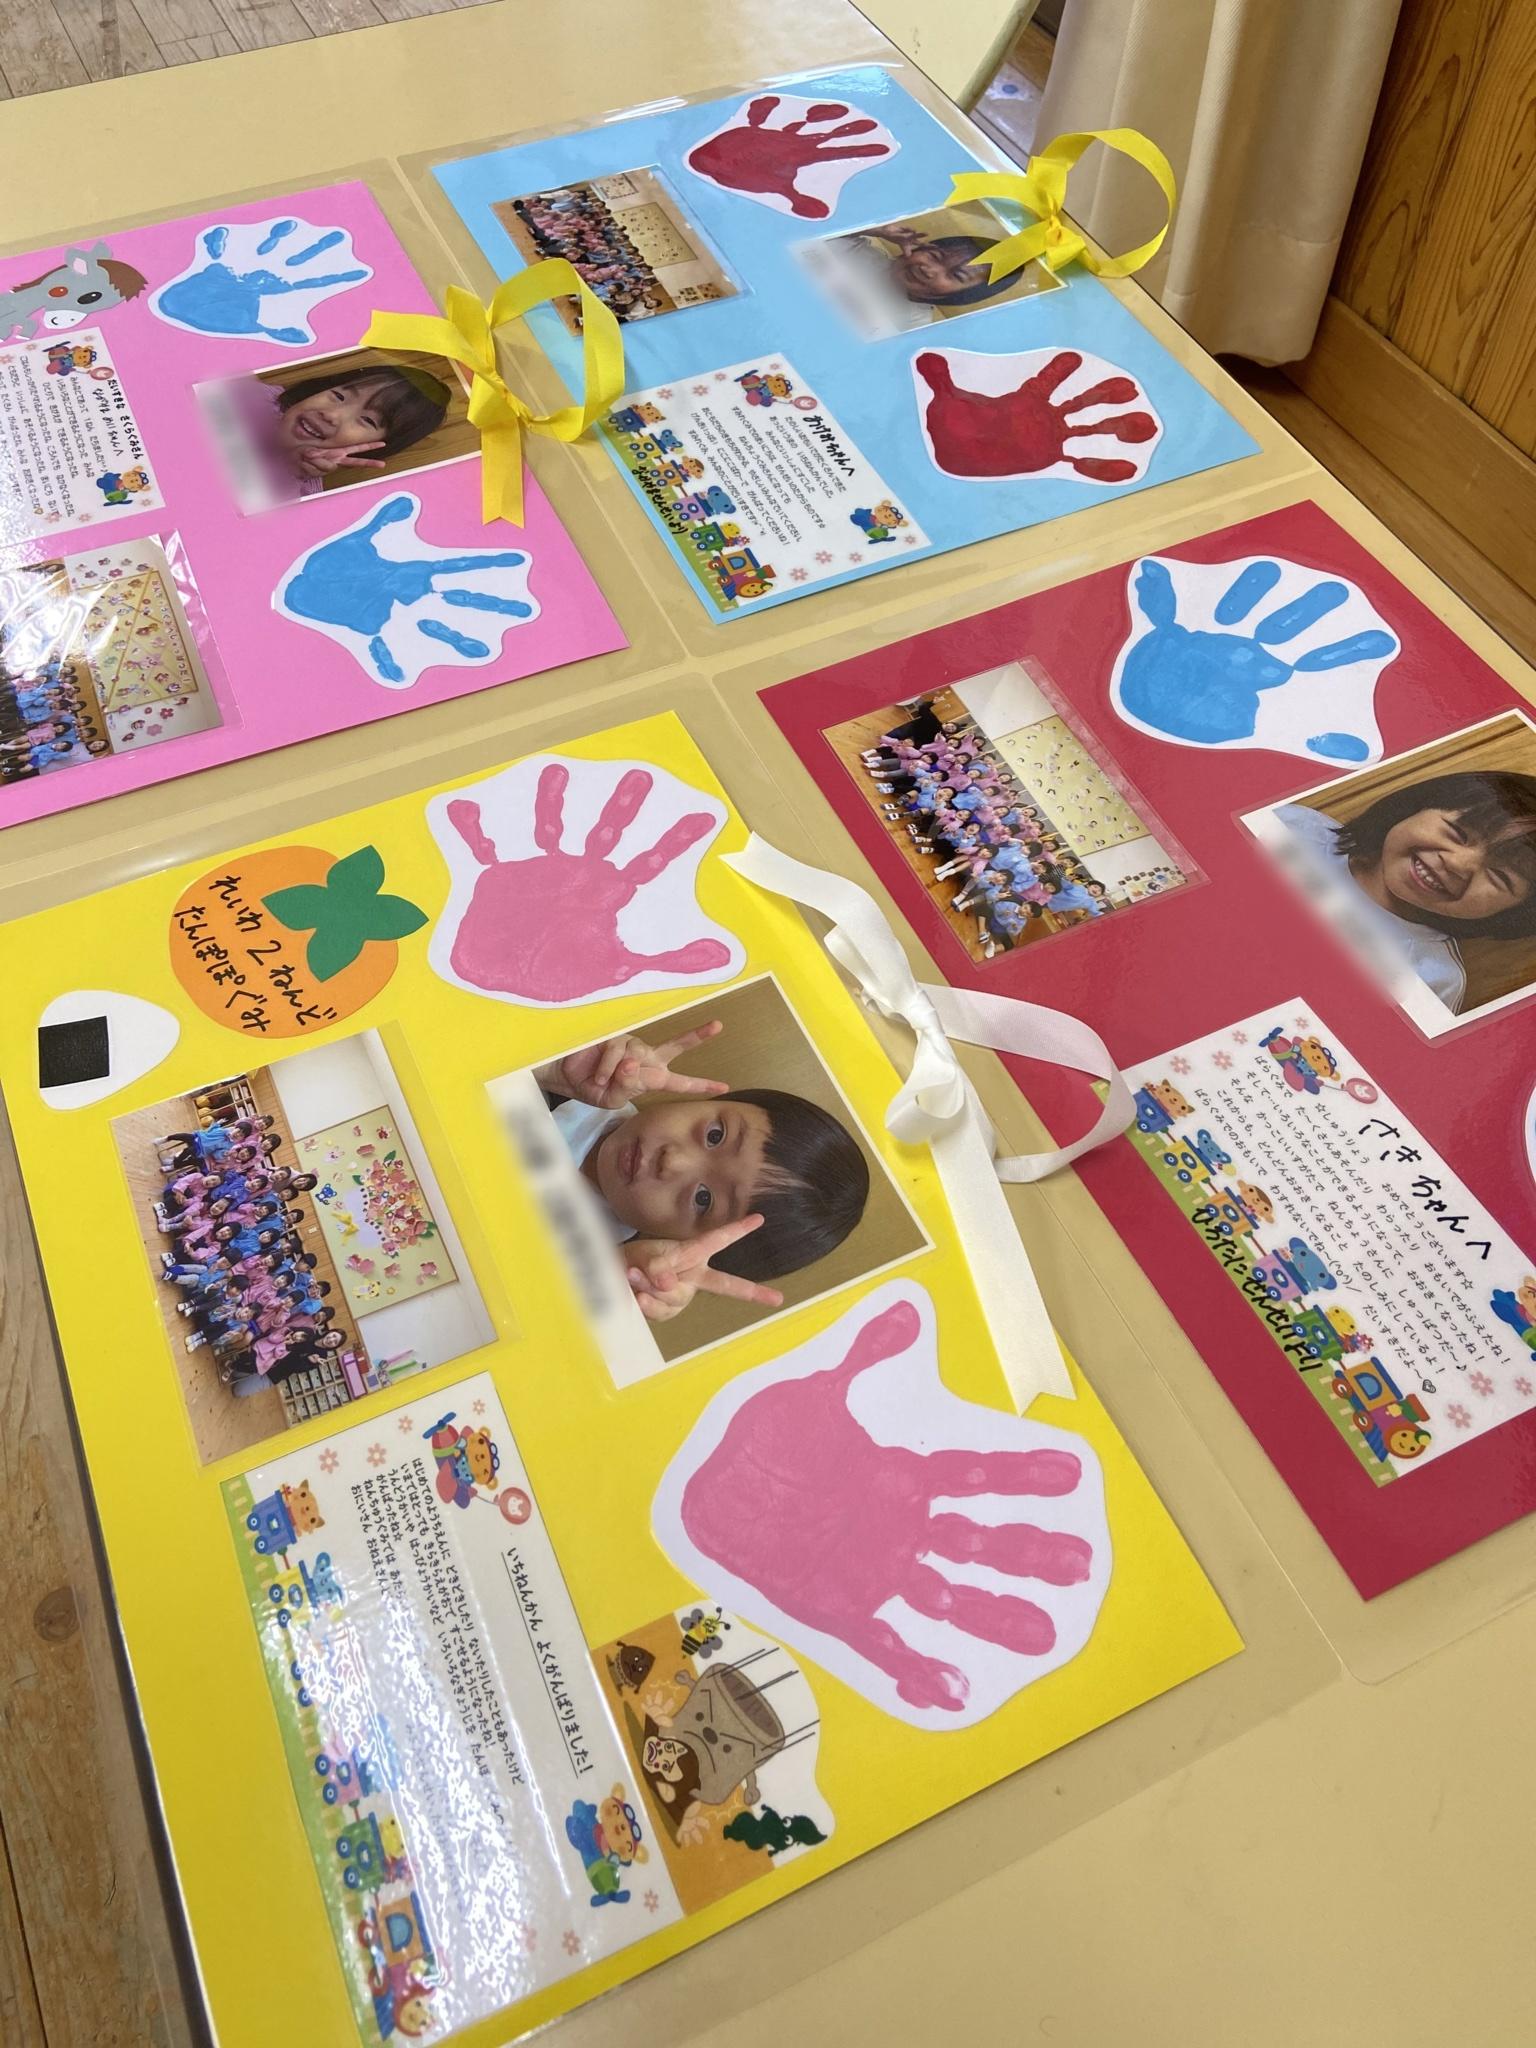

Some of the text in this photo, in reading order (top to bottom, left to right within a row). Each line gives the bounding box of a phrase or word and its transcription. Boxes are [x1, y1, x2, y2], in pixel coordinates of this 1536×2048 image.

[174, 906, 270, 1032] たんぽぽぐみ
[1194, 1088, 1268, 1176] ばらぐみでのおもいで
[1231, 1078, 1254, 1104] そんな
[1256, 1111, 1325, 1192] かっこいいすがたで
[1327, 1201, 1394, 1279] ねんちょうさんに
[1254, 1055, 1293, 1098] ばらぐみで
[1376, 1204, 1420, 1251] わらったり
[350, 1484, 373, 1533] おにいさん
[363, 1479, 396, 1565] ねんちゅうぐみでは
[400, 1463, 430, 1536] いまではとっても
[424, 1541, 457, 1618] きらきらえがおで
[387, 1468, 415, 1533] うんどうかいや
[437, 1631, 476, 1734] いろいろなぎょうじを
[412, 1457, 524, 1785] はじめてのようちえんに どきどきしたり ないたりしたこともあったけど
[507, 1547, 543, 1632] いちねんかん
